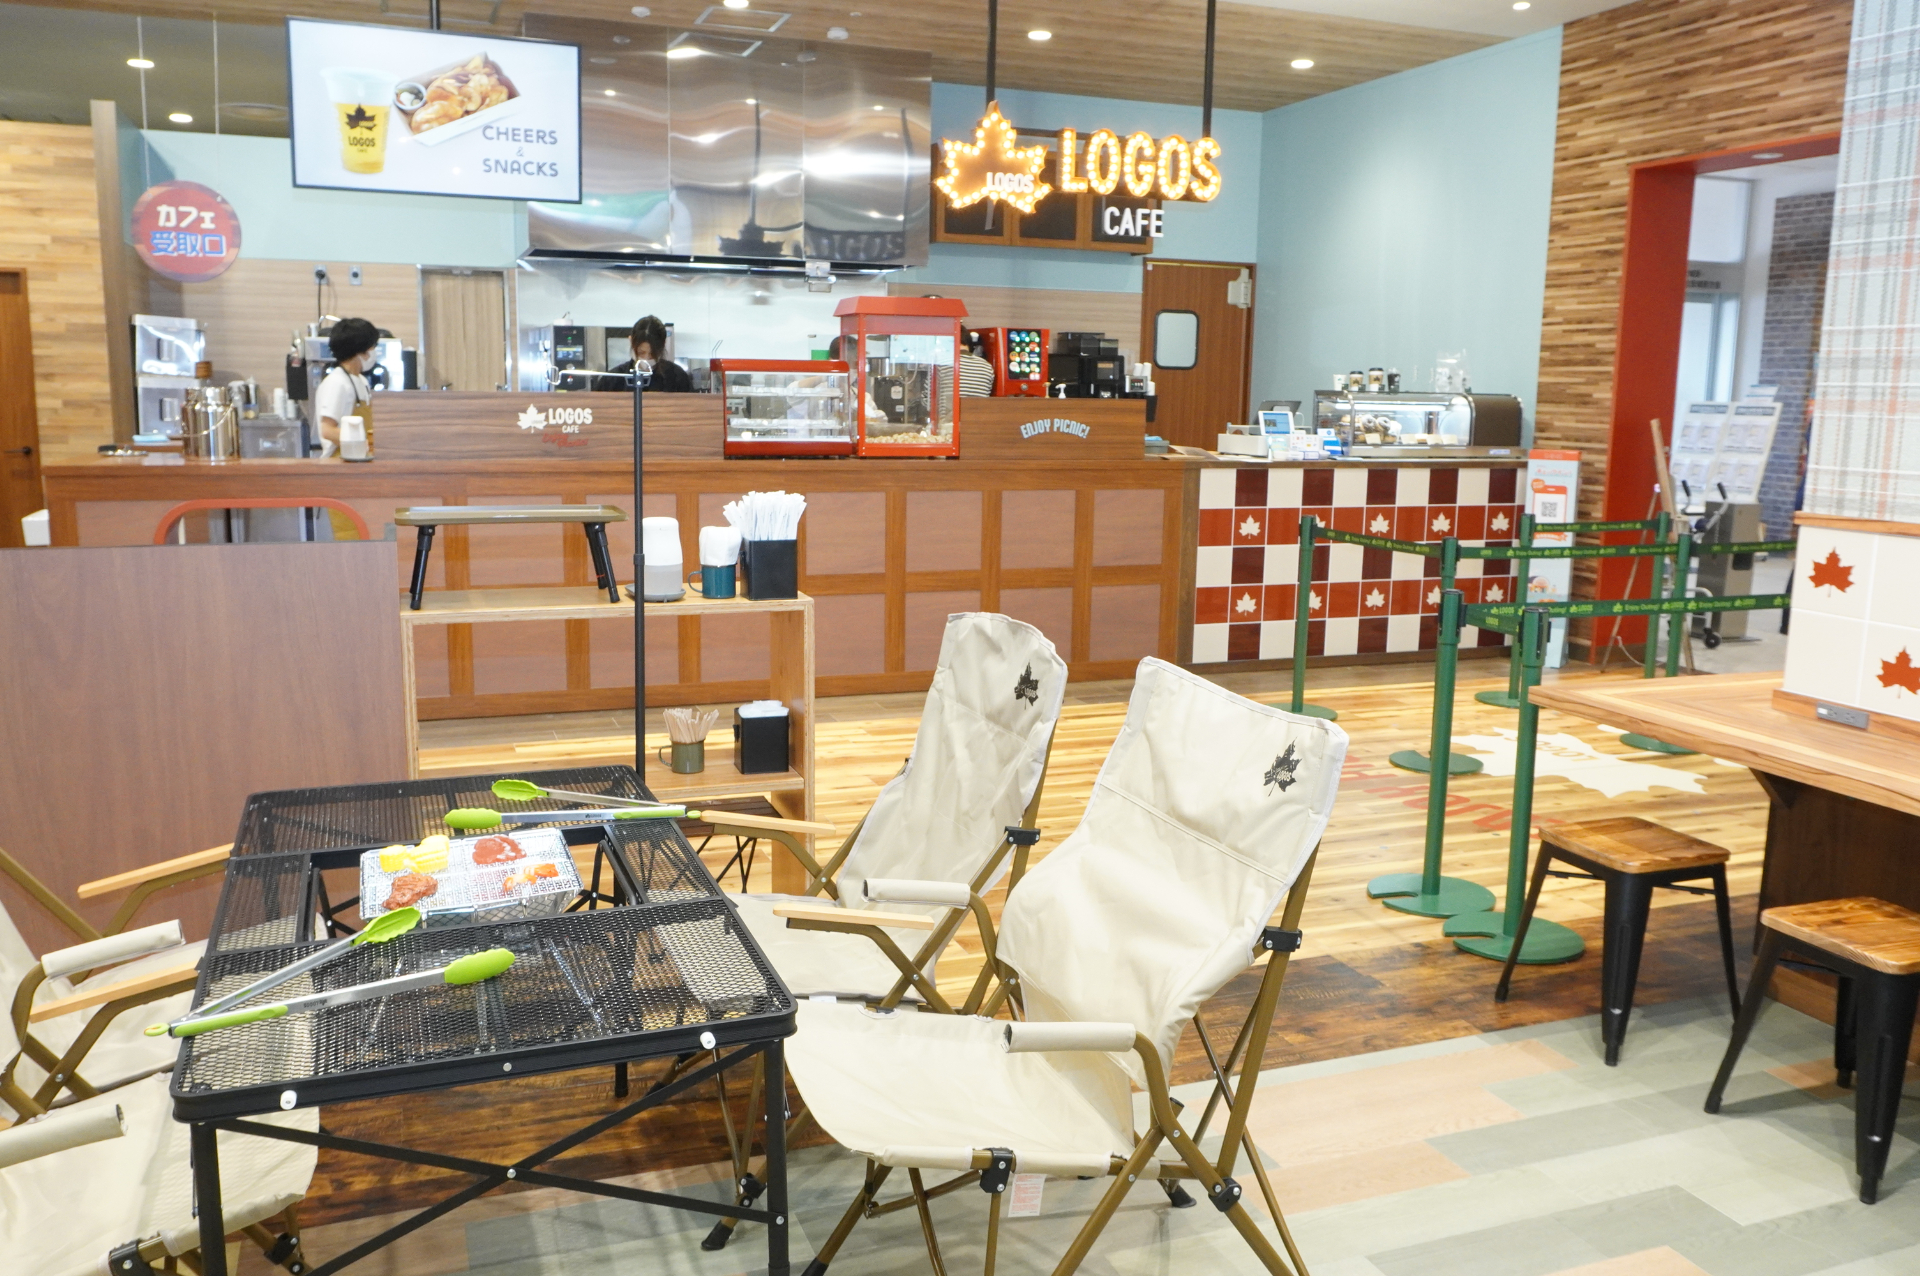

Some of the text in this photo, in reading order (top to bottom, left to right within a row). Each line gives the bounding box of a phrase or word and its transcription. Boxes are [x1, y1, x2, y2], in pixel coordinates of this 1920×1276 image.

[348, 136, 376, 147] LOGOS
[482, 125, 558, 145] CHEERS
[482, 158, 559, 177] SNACKS
[1056, 127, 1222, 202] LOGOS
[986, 171, 1035, 193] LOGOS
[156, 204, 217, 229] カフェ
[1102, 205, 1165, 238] CAFE
[150, 230, 227, 257] 受取口
[548, 407, 593, 425] LOGOS
[562, 425, 579, 433] CAFE
[1020, 418, 1051, 438] ENJOY
